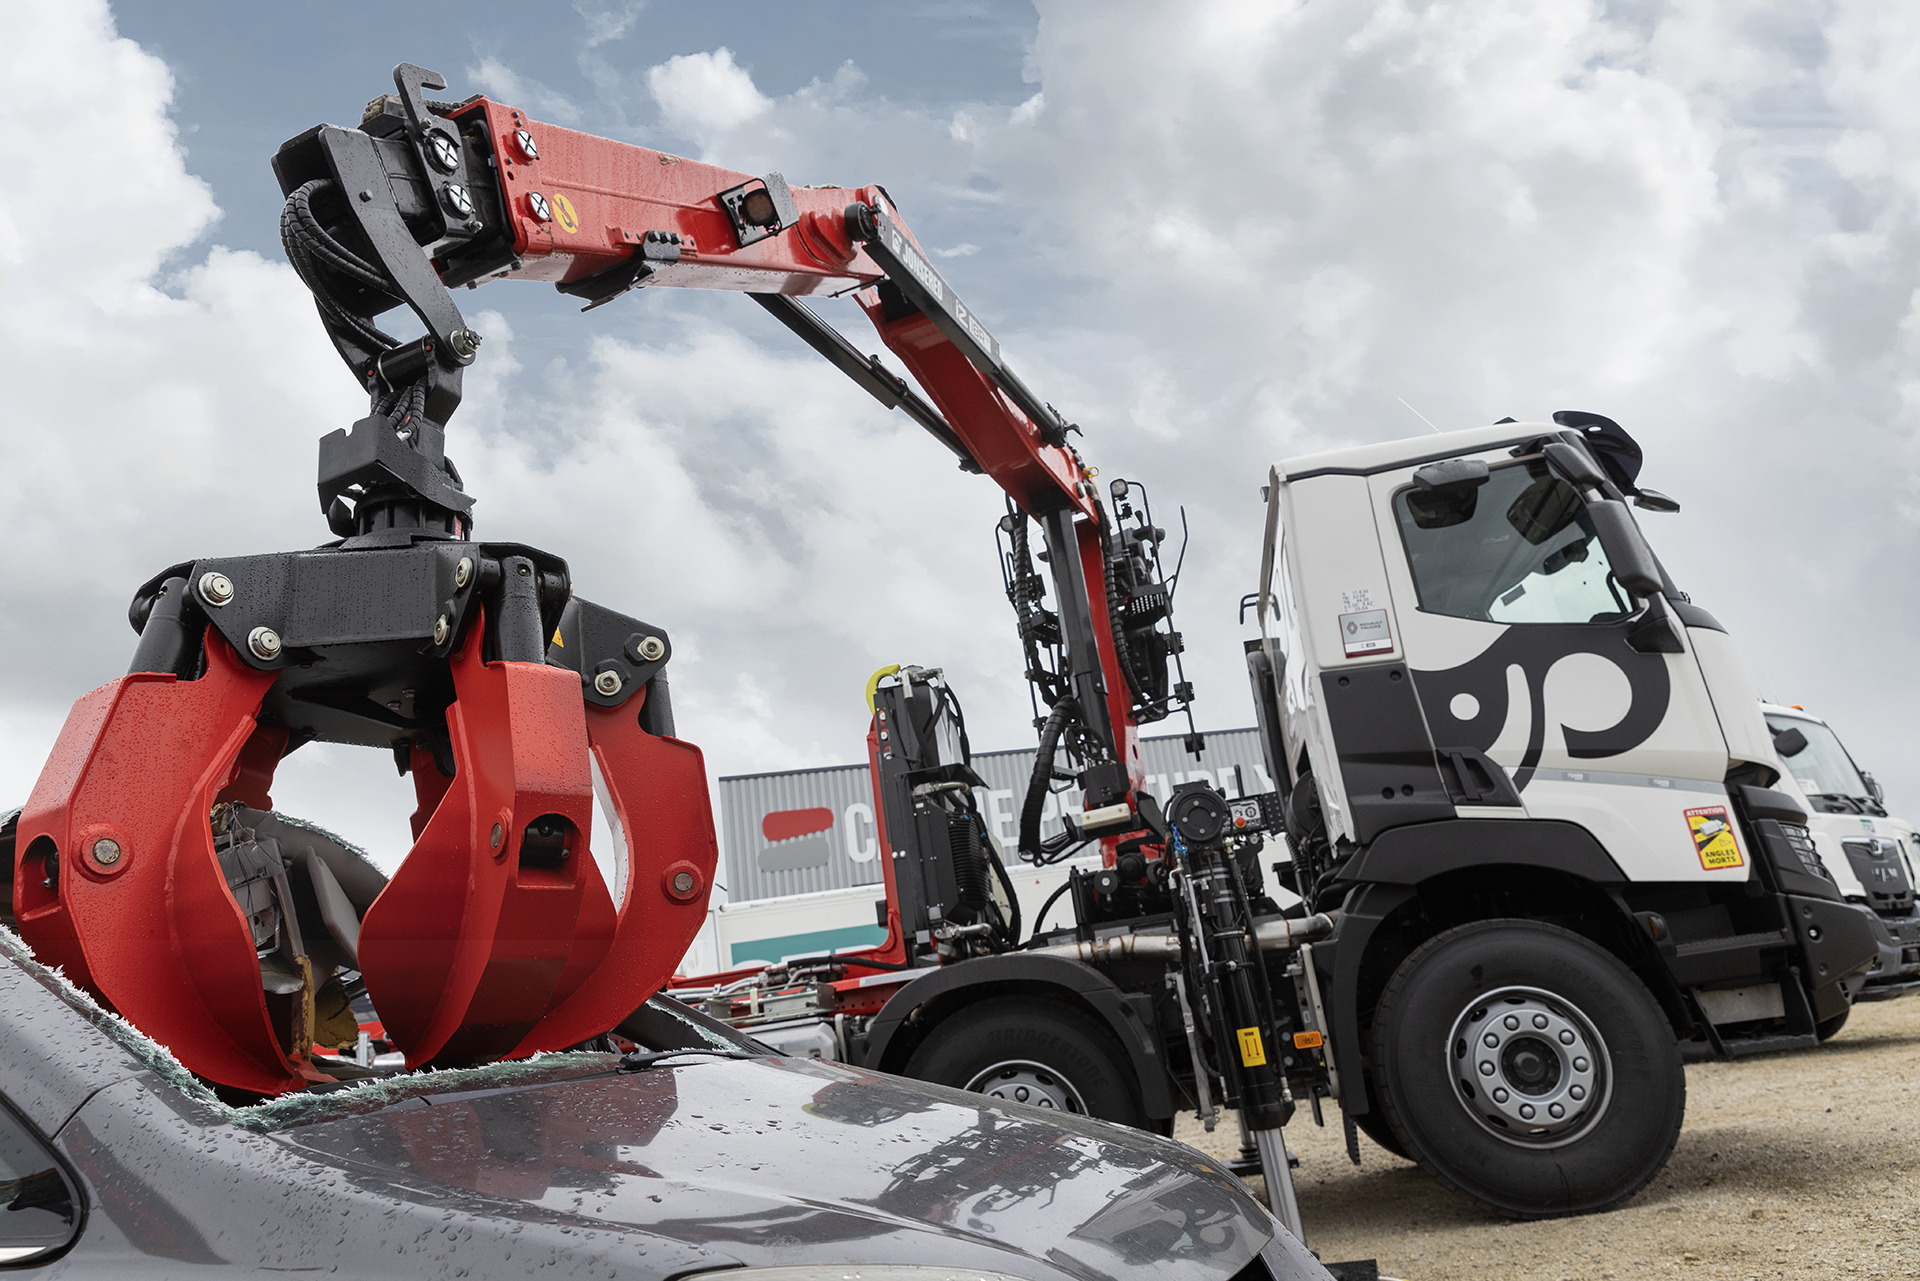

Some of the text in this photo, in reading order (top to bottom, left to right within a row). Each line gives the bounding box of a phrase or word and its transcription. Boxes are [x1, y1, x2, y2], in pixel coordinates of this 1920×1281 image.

[903, 243, 943, 301] JONSERED
[1686, 807, 1725, 816] ATTENTION
[1705, 849, 1735, 858] ANGLES
[1708, 856, 1736, 865] MORTS
